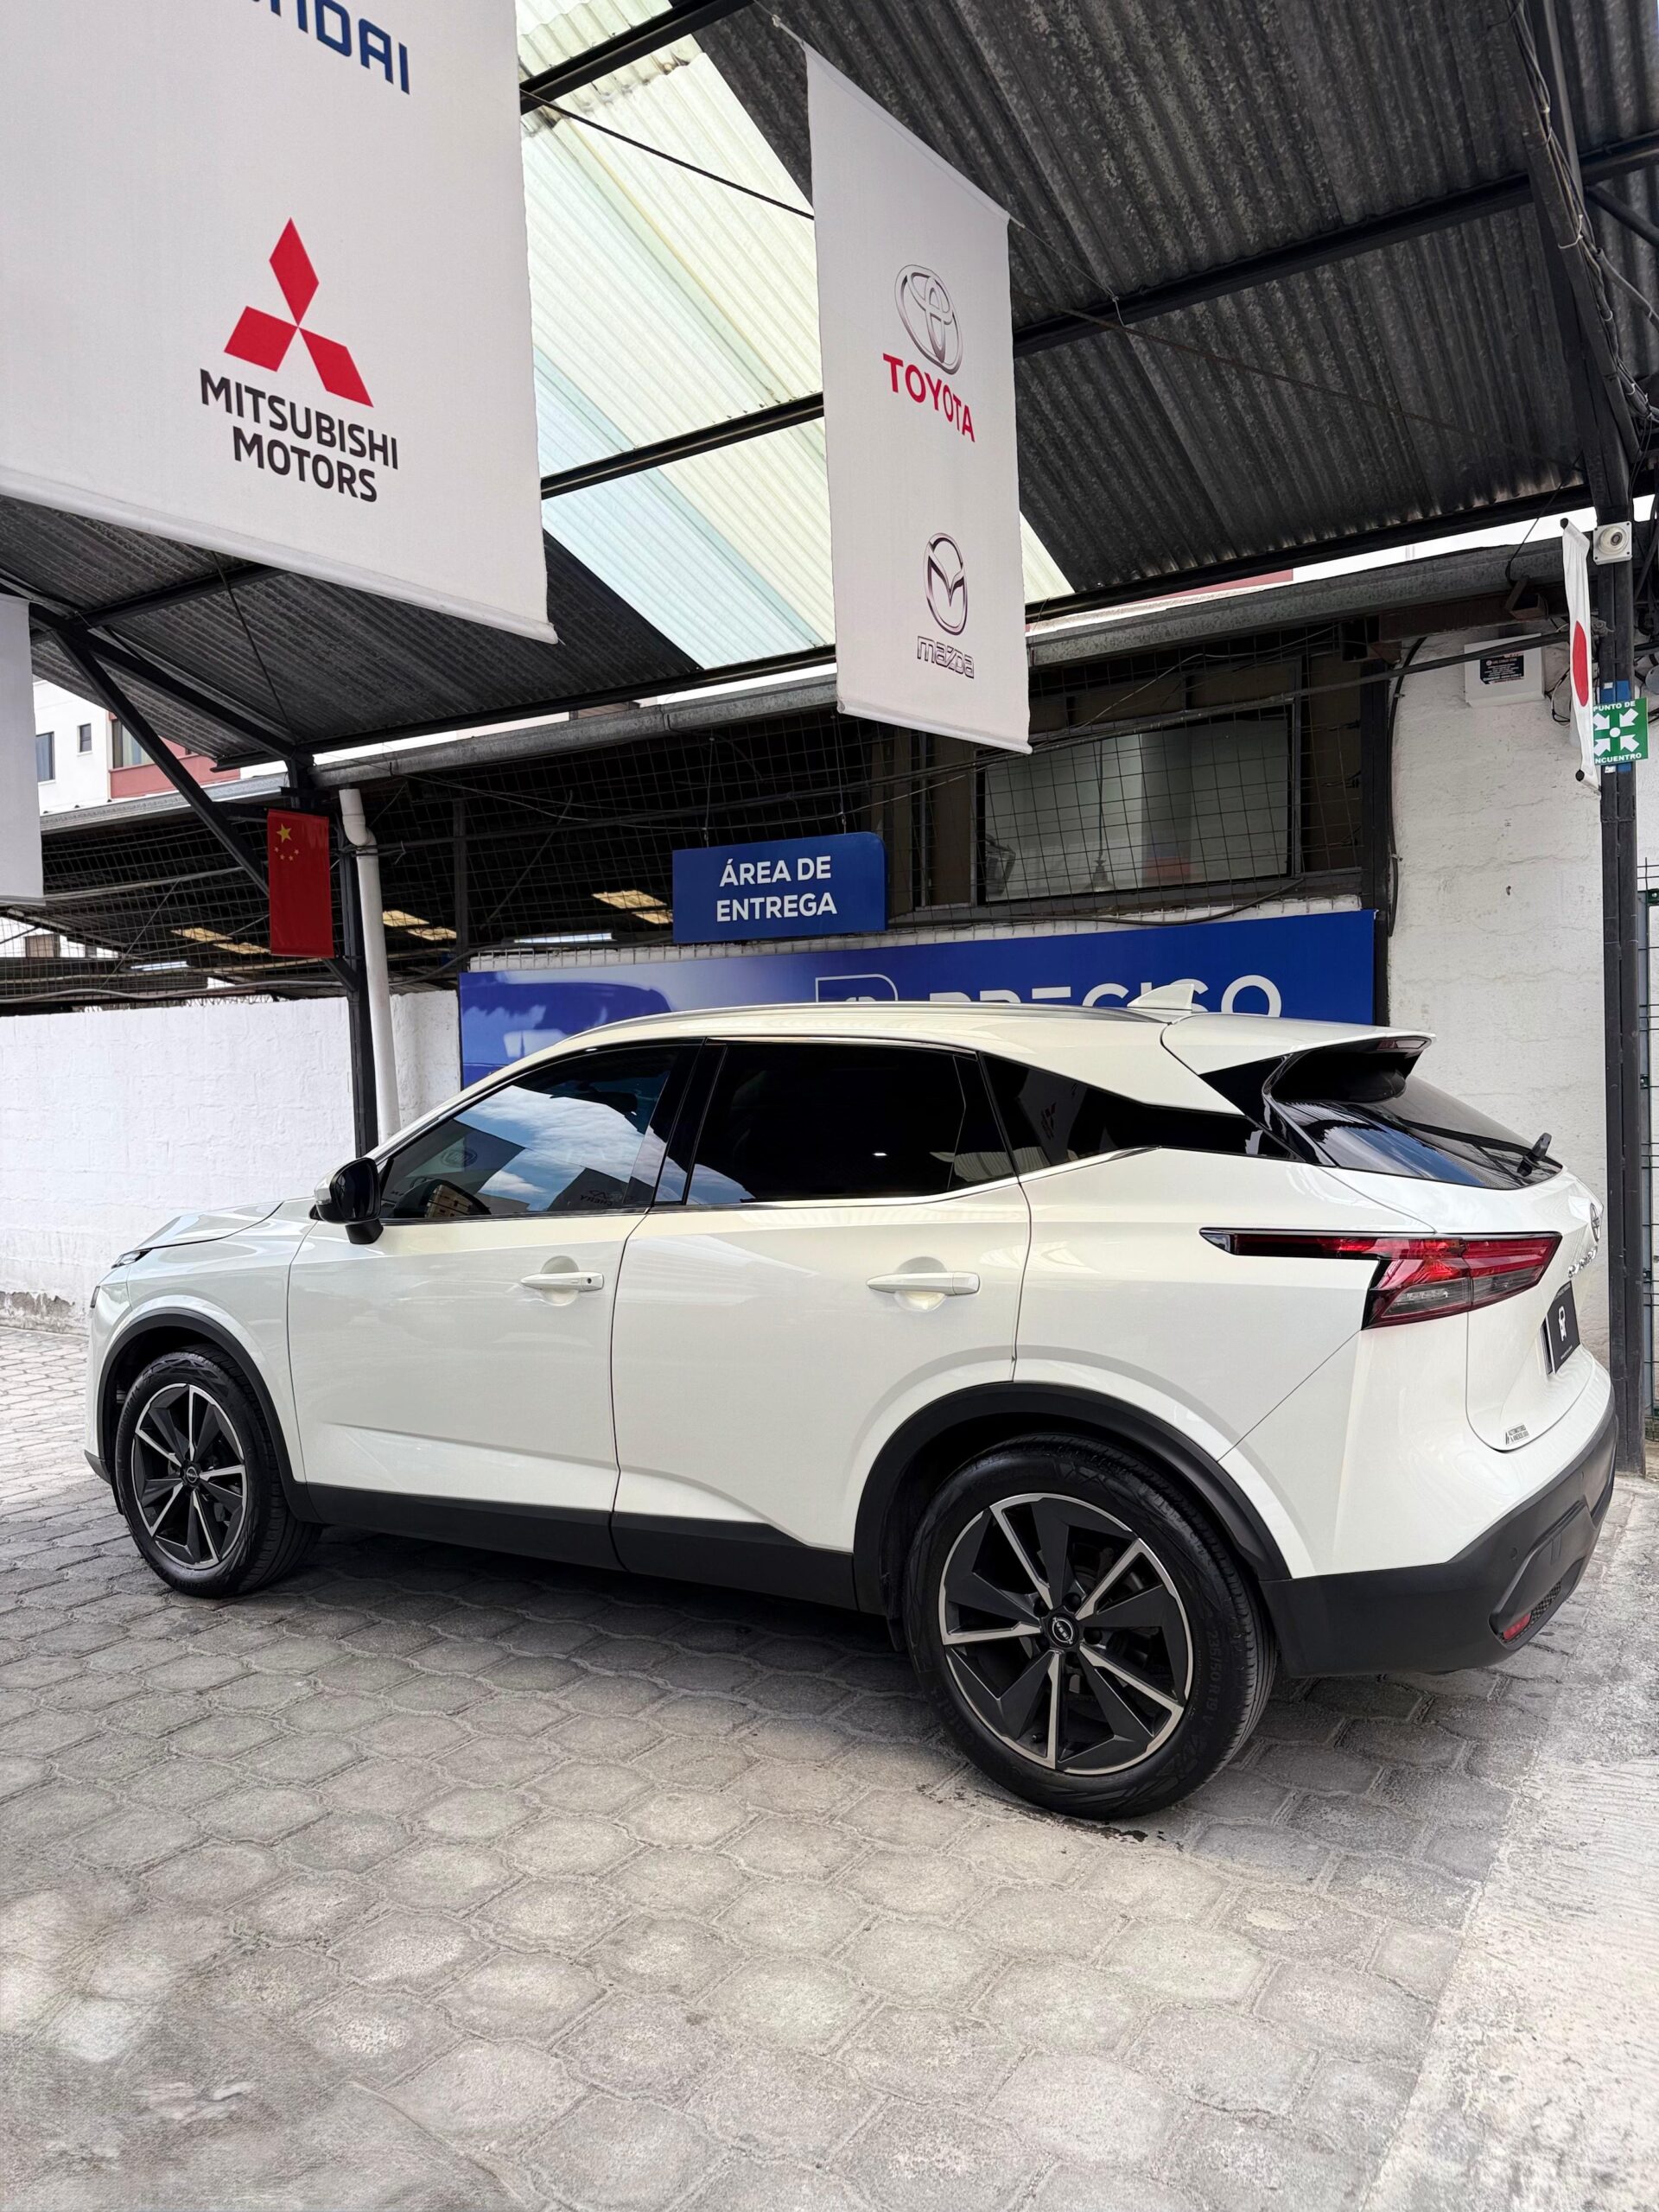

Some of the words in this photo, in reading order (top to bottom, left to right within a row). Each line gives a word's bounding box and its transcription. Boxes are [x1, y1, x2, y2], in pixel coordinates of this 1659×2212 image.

[883, 353, 976, 443] TOYOTA
[200, 368, 398, 470] MITSUBISHI
[232, 426, 378, 503] MOTORS
[917, 636, 975, 679] mazda
[1593, 702, 1622, 712] PUNTO
[1595, 753, 1642, 764] NCUENTRO
[719, 858, 792, 887] ÁREA
[797, 855, 832, 880] DE
[715, 892, 838, 922] ENTREGA
